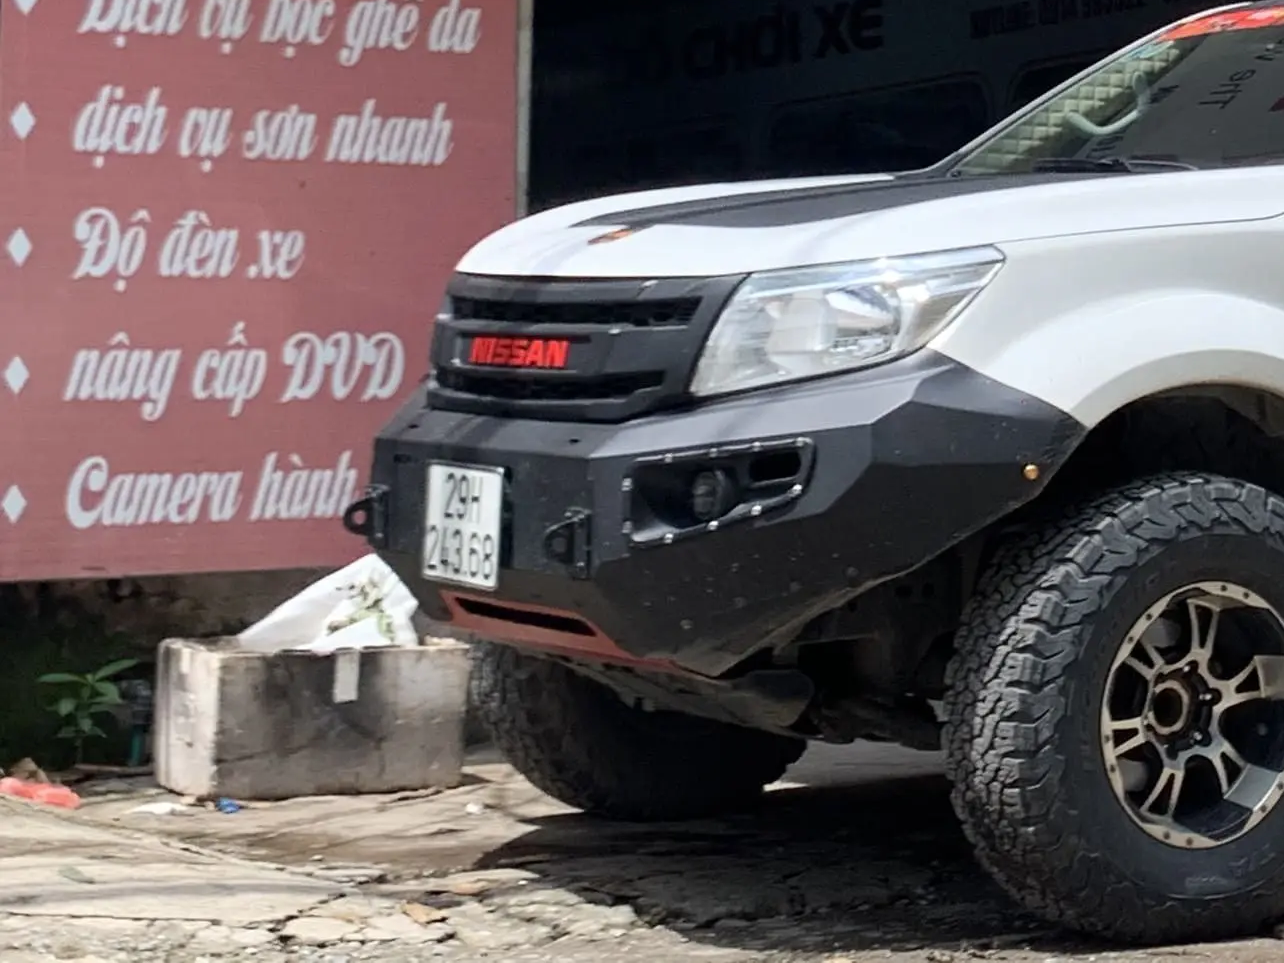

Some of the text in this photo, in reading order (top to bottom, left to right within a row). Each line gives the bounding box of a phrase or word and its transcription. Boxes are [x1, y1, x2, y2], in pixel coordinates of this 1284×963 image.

[72, 84, 455, 173] dịch vụ sơn nhanh
[72, 206, 153, 293] Độ
[246, 228, 306, 281] xe
[63, 320, 405, 421] nâng cấp DVD
[469, 333, 569, 370] NISSAN
[66, 448, 361, 530] Camera hành
[444, 471, 483, 524] 29H
[426, 524, 494, 581] 243.68
